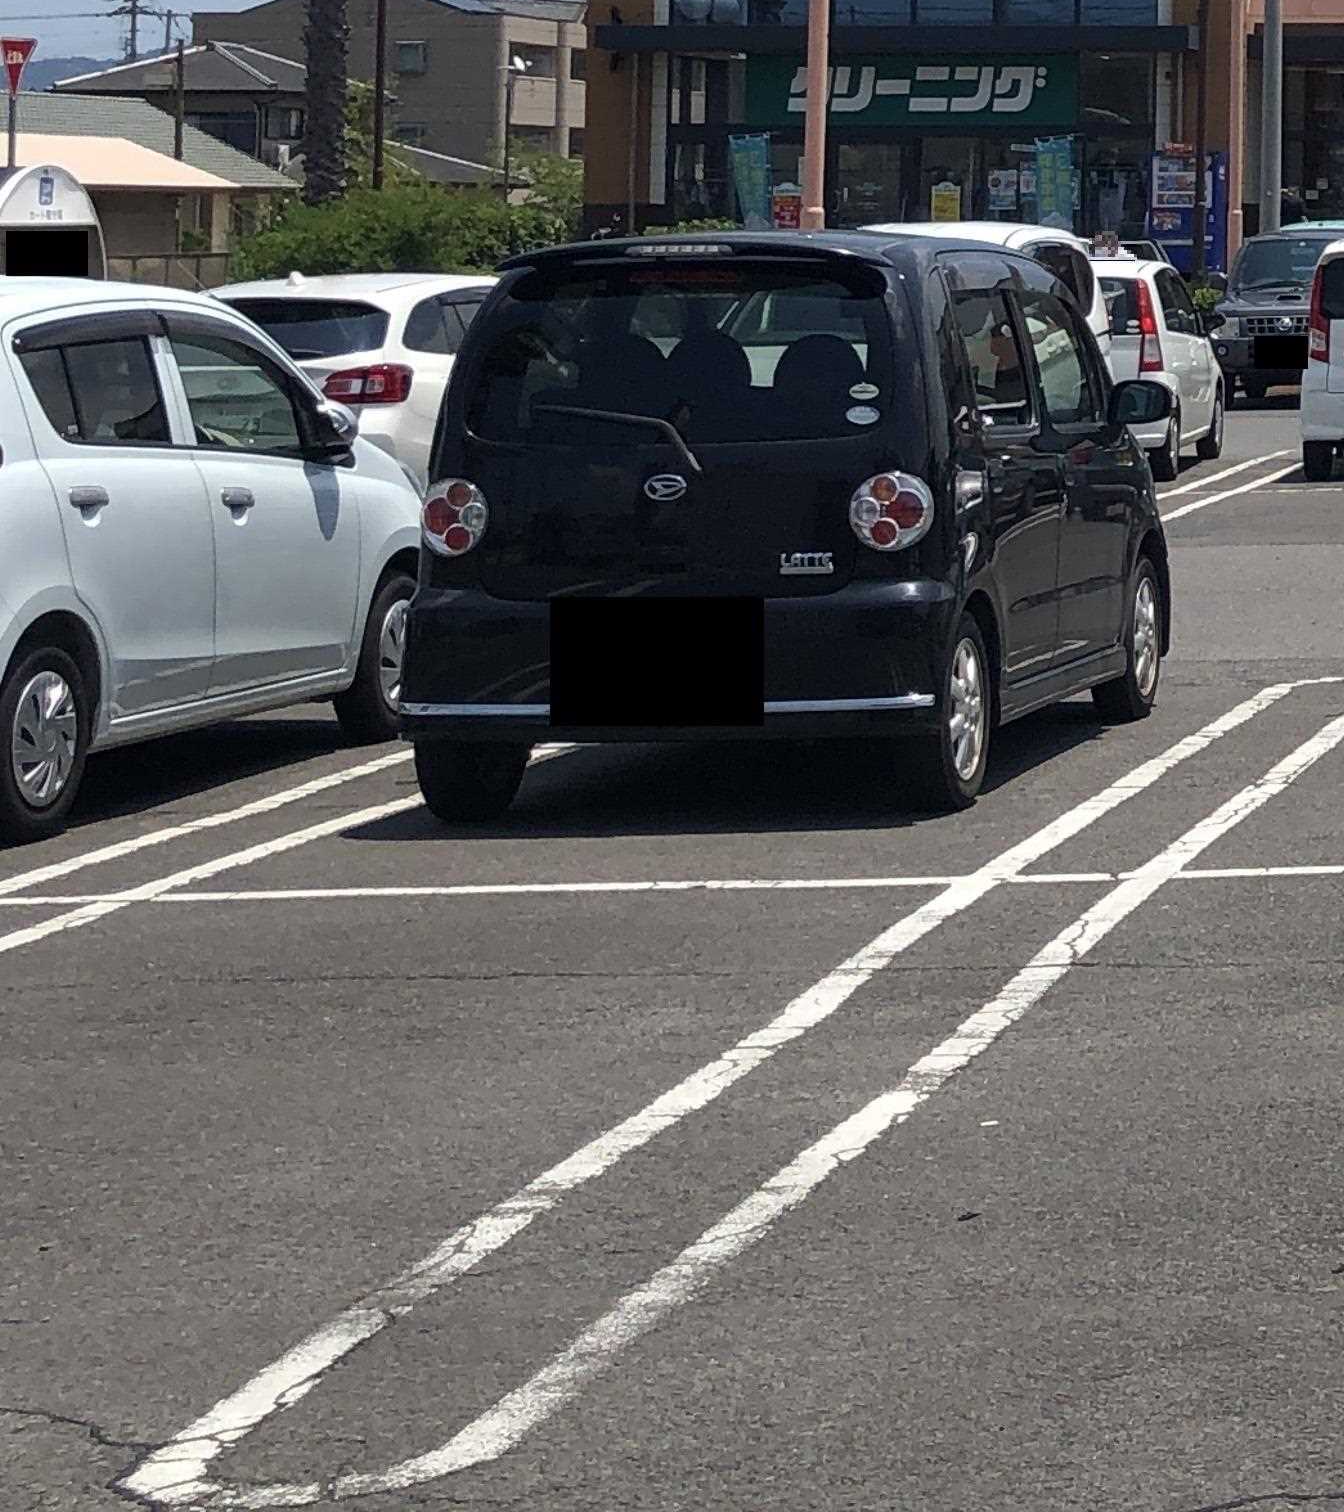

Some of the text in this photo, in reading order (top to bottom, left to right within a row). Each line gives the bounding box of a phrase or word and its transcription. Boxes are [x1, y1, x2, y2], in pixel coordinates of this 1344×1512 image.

[787, 66, 1048, 112] クリーニング
